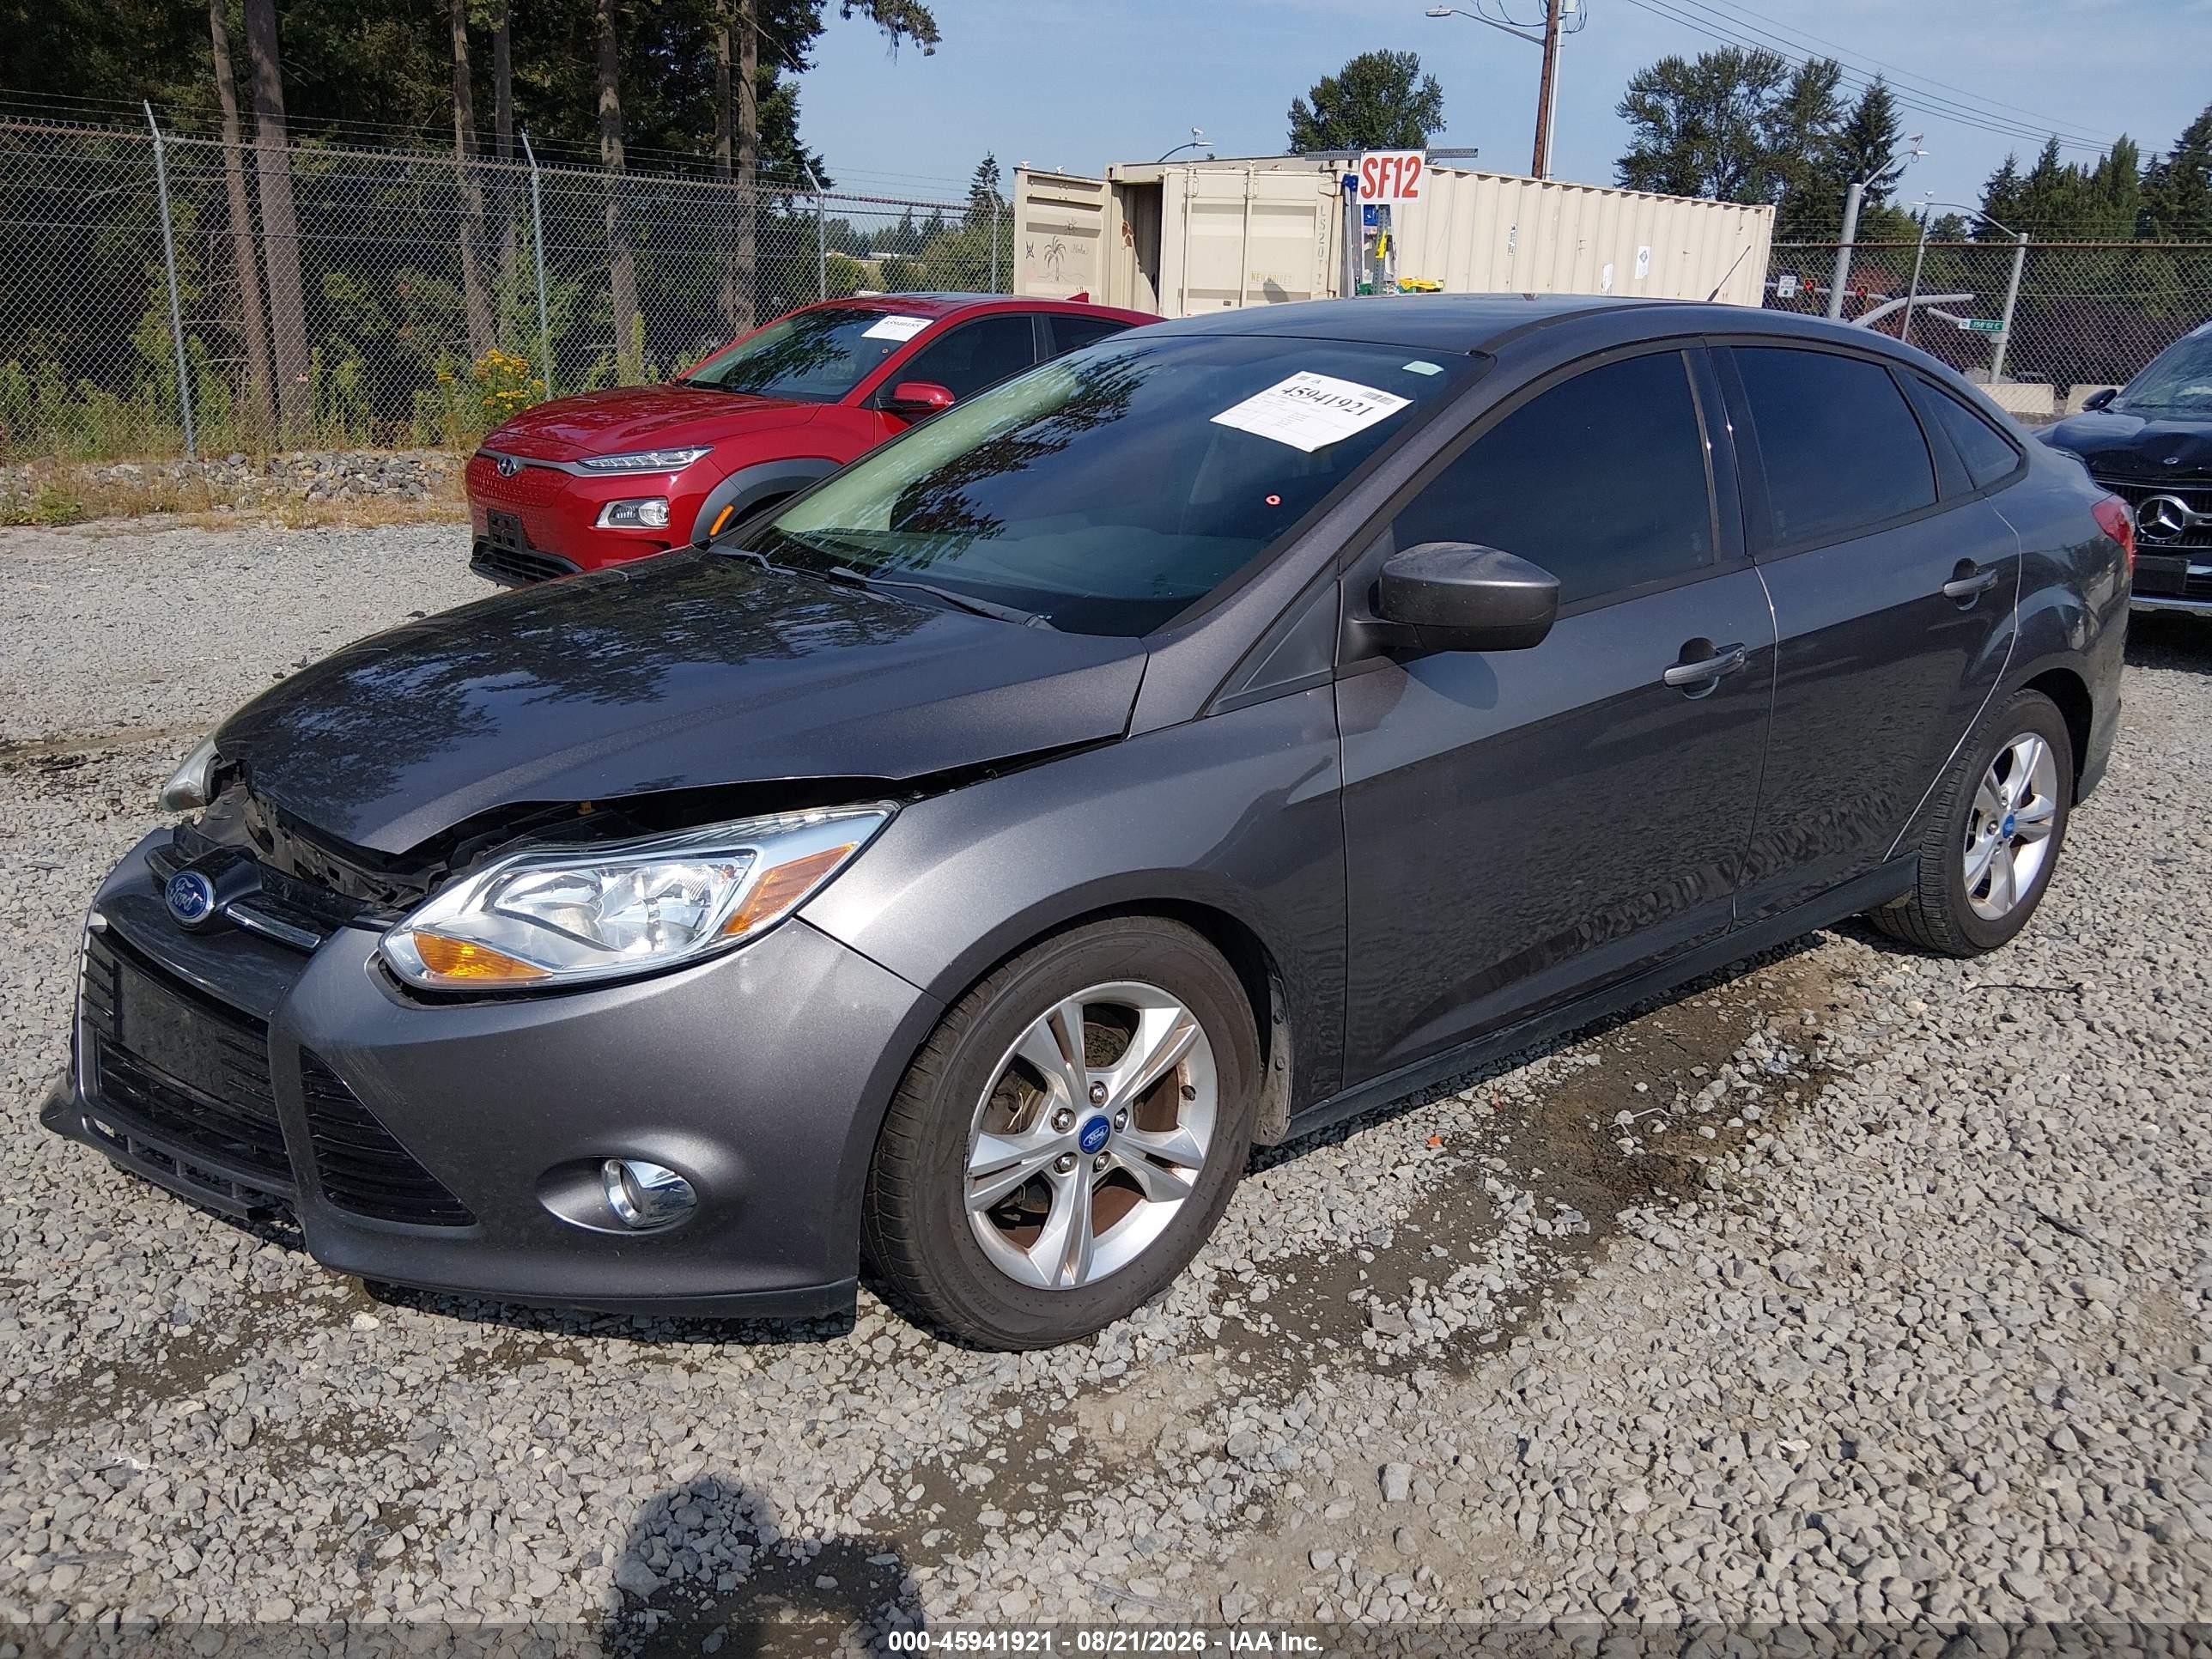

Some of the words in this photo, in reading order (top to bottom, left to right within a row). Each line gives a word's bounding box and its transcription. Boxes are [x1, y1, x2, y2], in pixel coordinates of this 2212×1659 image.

[1360, 155, 1422, 200] SF12
[1281, 385, 1376, 416] 45941921
[168, 877, 204, 911] Ford
